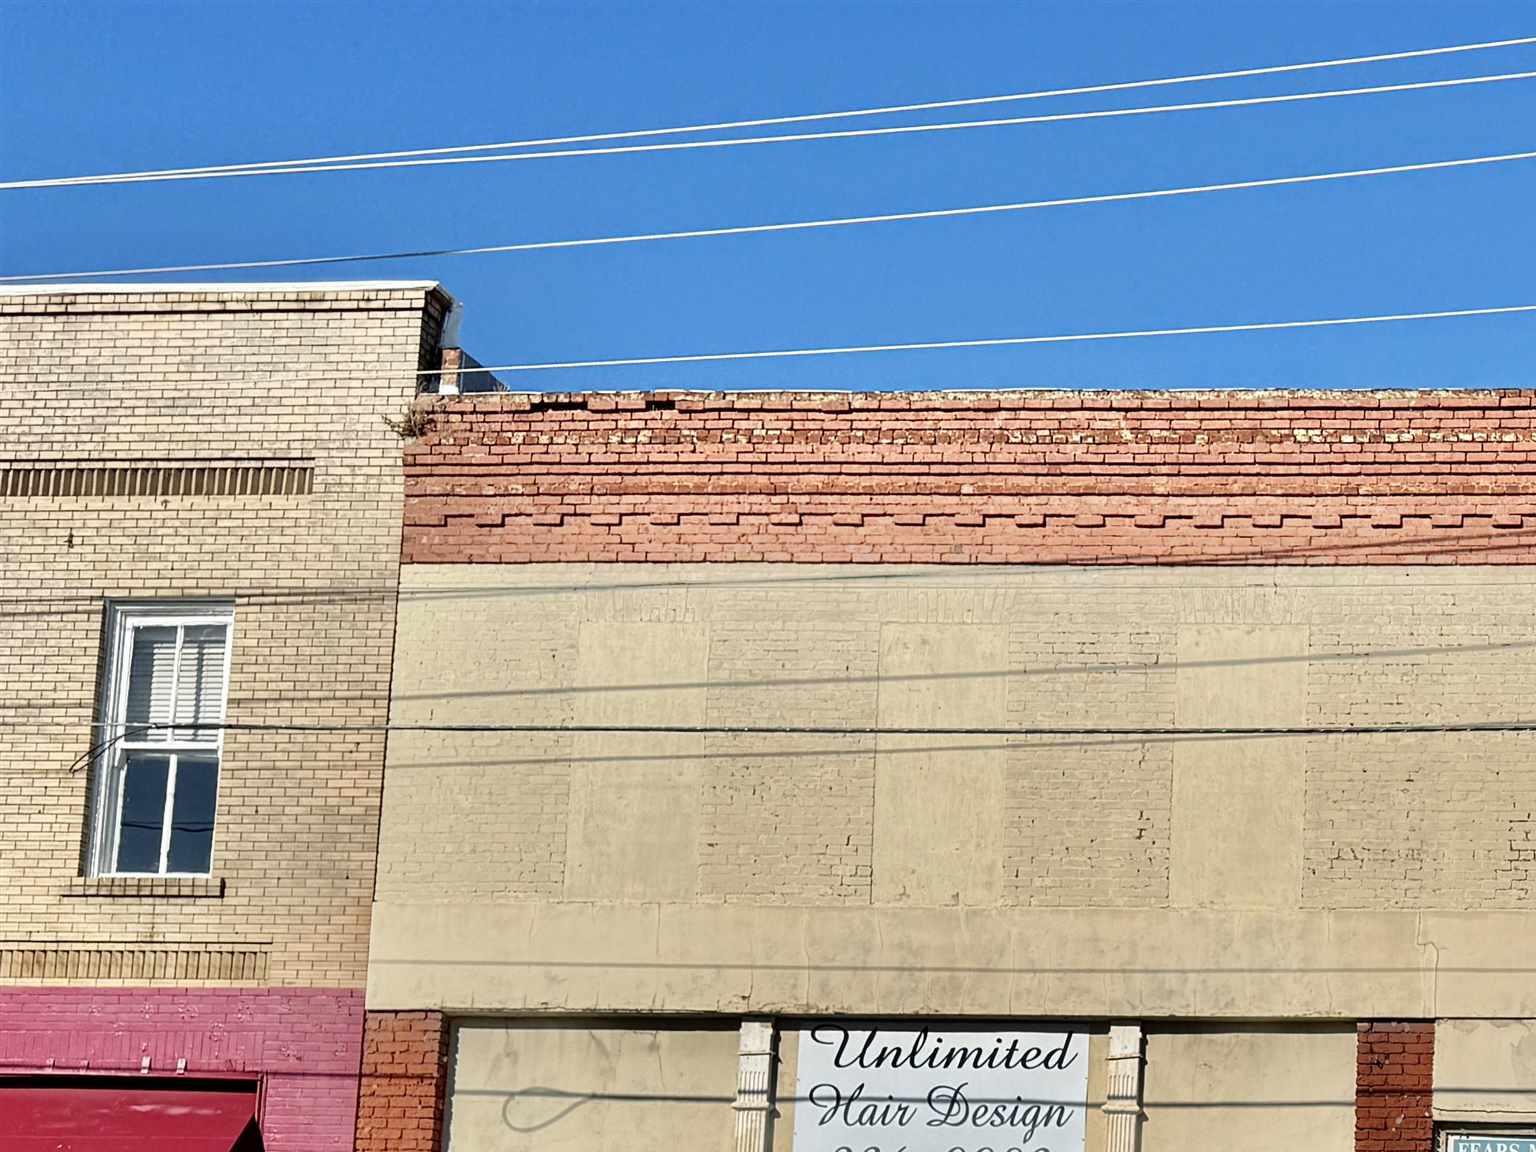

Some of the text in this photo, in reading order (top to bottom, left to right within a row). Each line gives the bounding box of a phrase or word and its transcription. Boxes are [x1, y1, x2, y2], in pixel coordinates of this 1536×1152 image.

[811, 1024, 1079, 1069] Unlimited
[808, 1082, 1074, 1143] Hair Design
